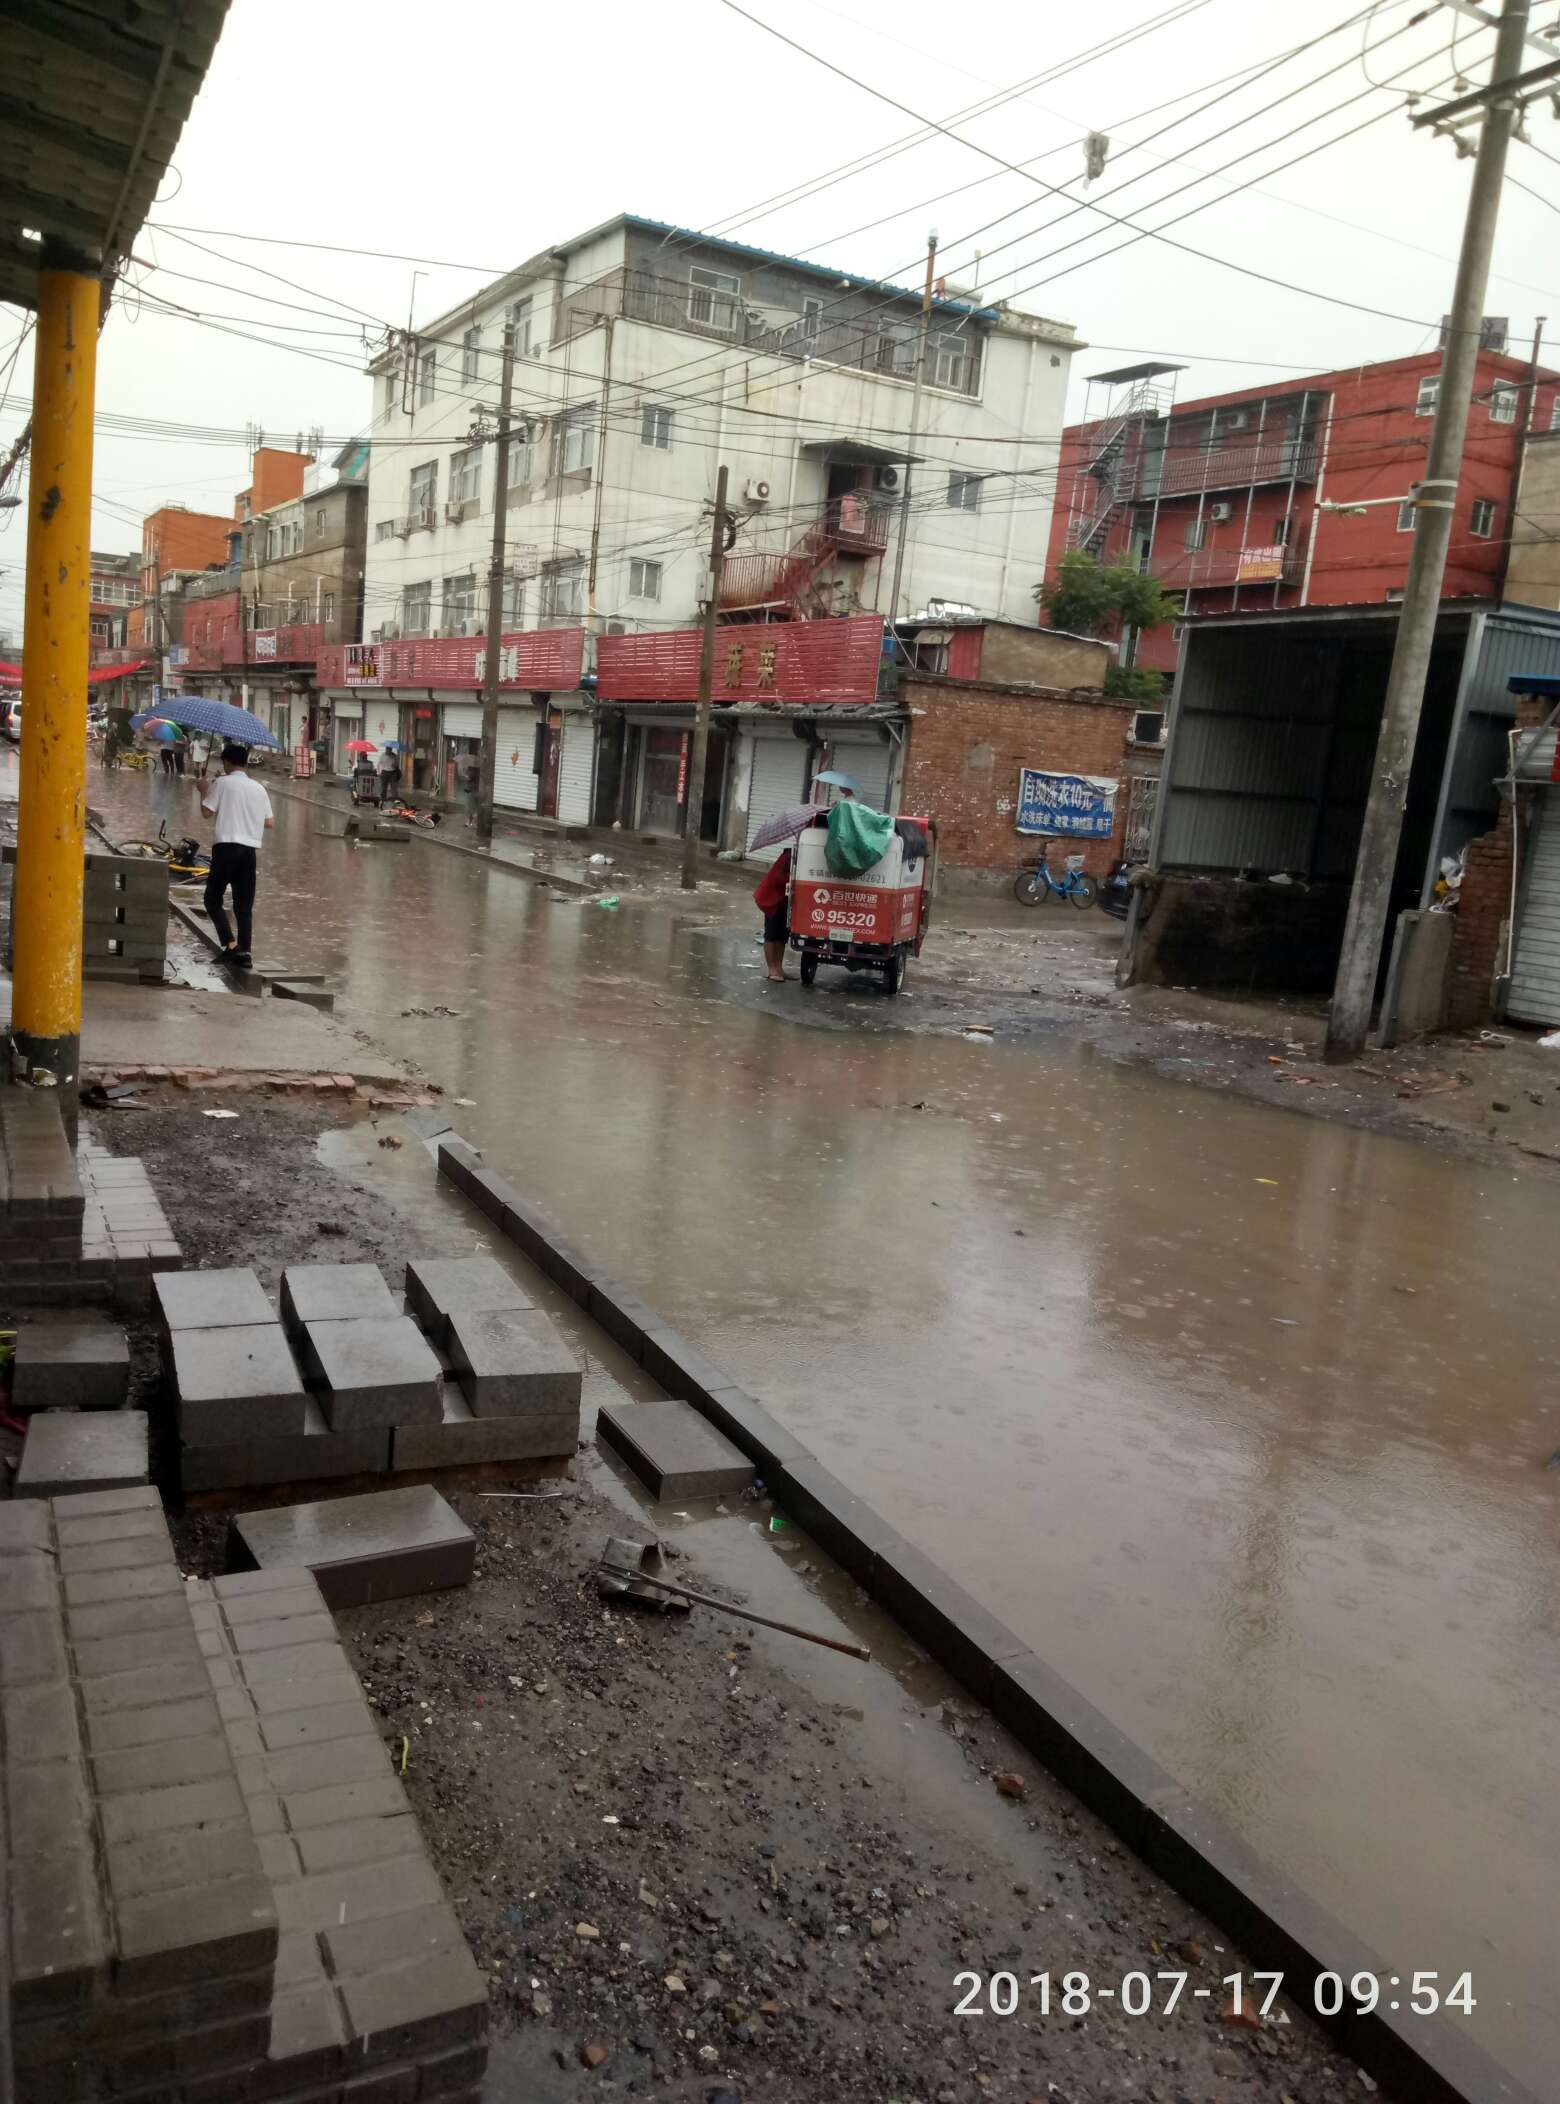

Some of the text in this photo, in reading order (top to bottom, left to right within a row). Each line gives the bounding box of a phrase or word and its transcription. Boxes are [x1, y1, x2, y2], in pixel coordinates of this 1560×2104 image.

[832, 890, 878, 904] 百世快递
[826, 910, 876, 927] 95320
